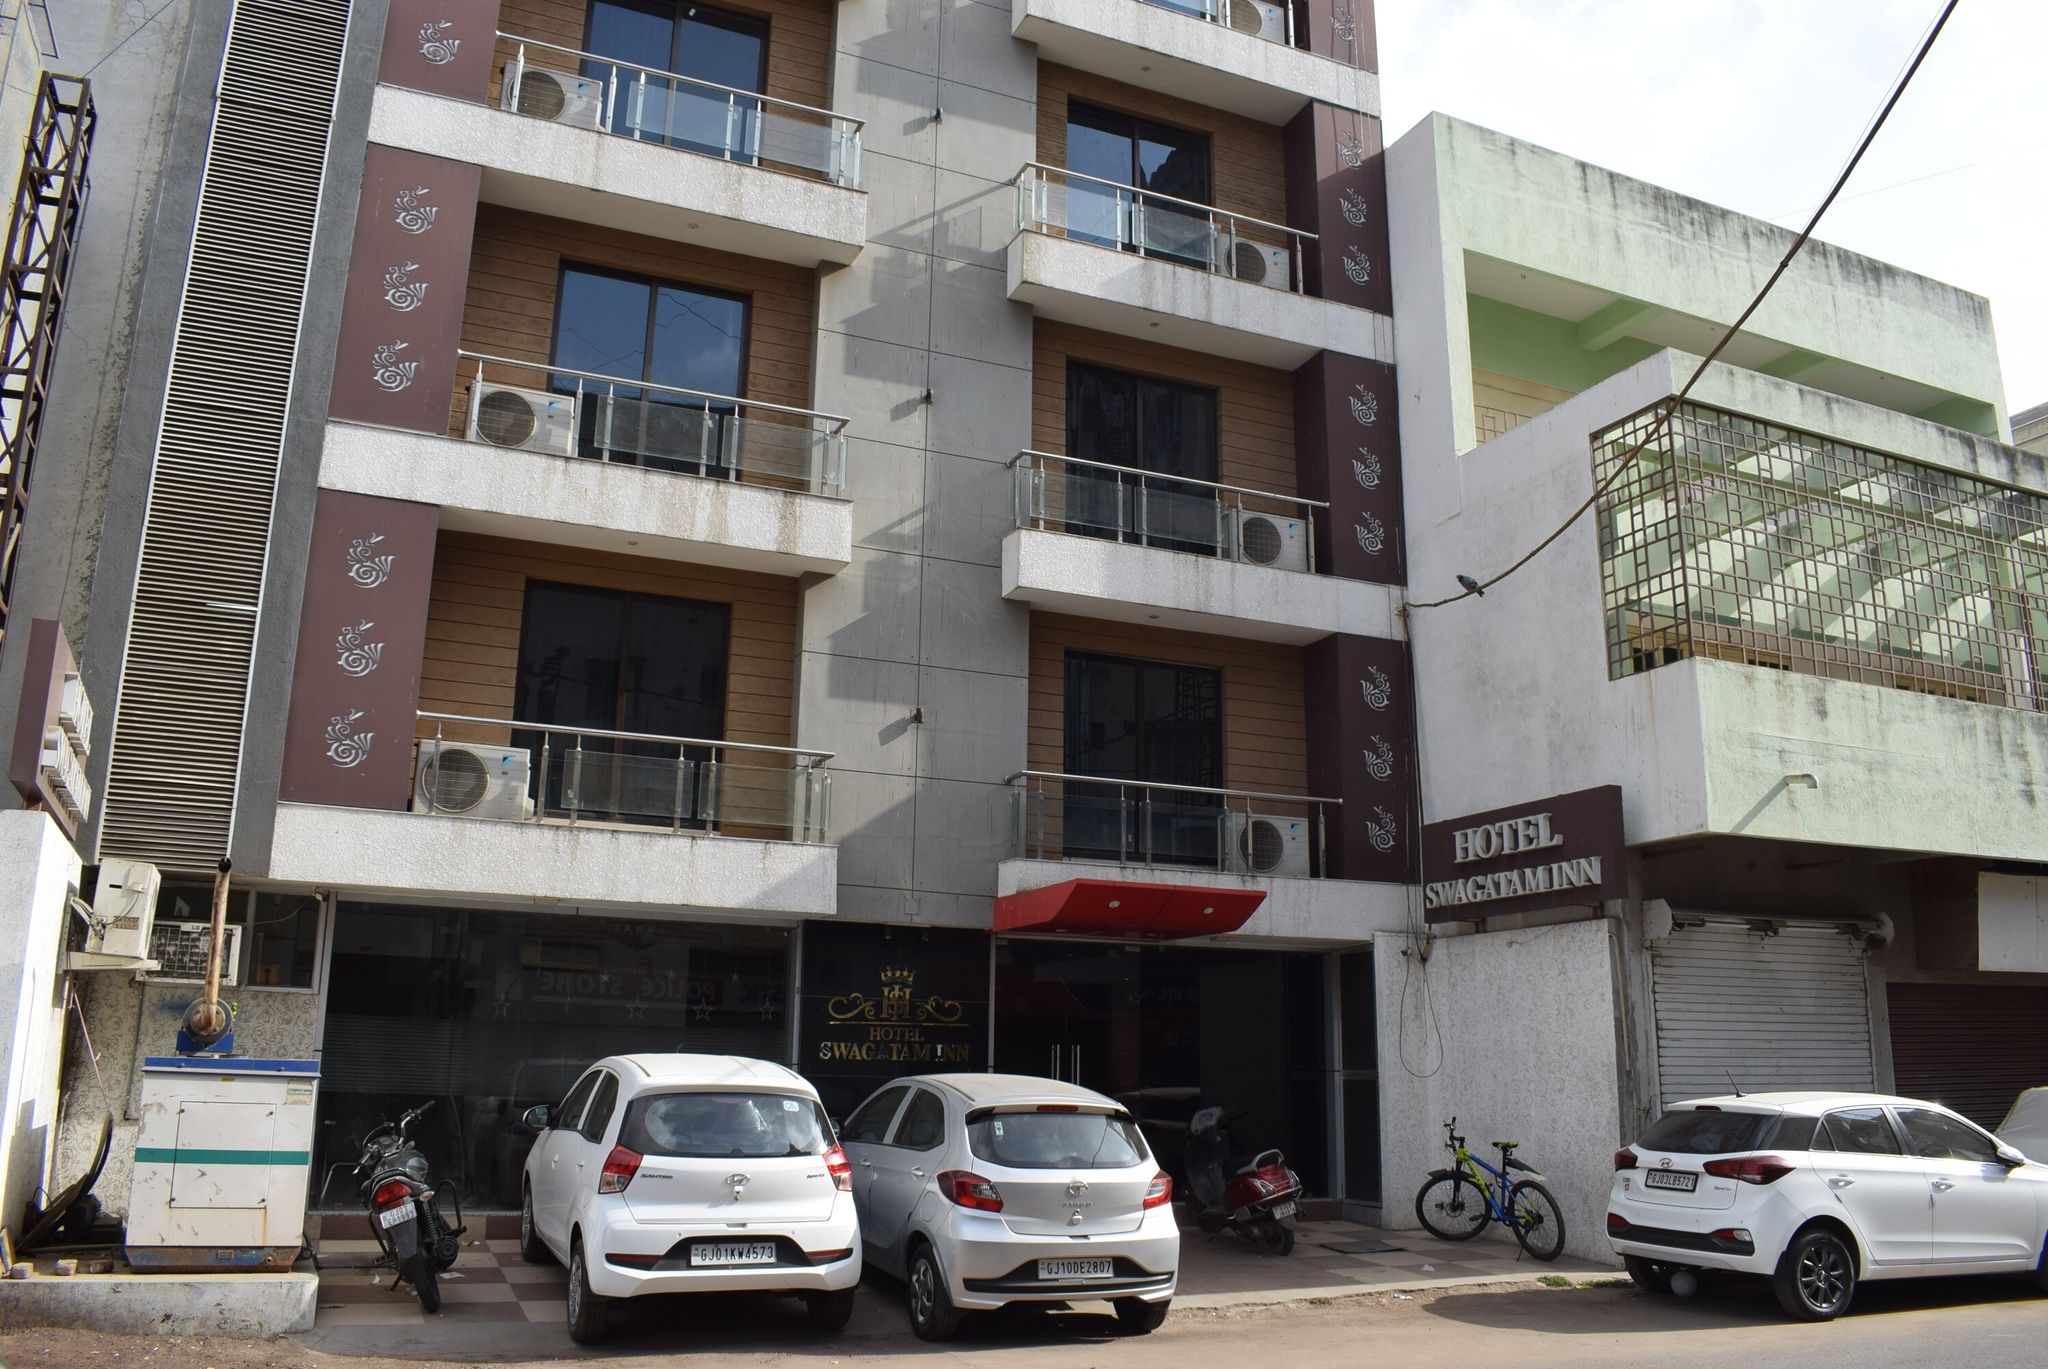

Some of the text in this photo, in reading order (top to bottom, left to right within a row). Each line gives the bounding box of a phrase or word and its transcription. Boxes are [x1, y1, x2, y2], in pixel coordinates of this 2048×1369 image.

[1453, 813, 1563, 863] HOTEL
[1426, 856, 1601, 908] SWAGATAM INN
[870, 1027, 924, 1041] HOTEL
[819, 1041, 970, 1062] SWAGATAM INN
[700, 1246, 774, 1261] GJ01KW4573
[1046, 1260, 1112, 1275] GJ10DE2807
